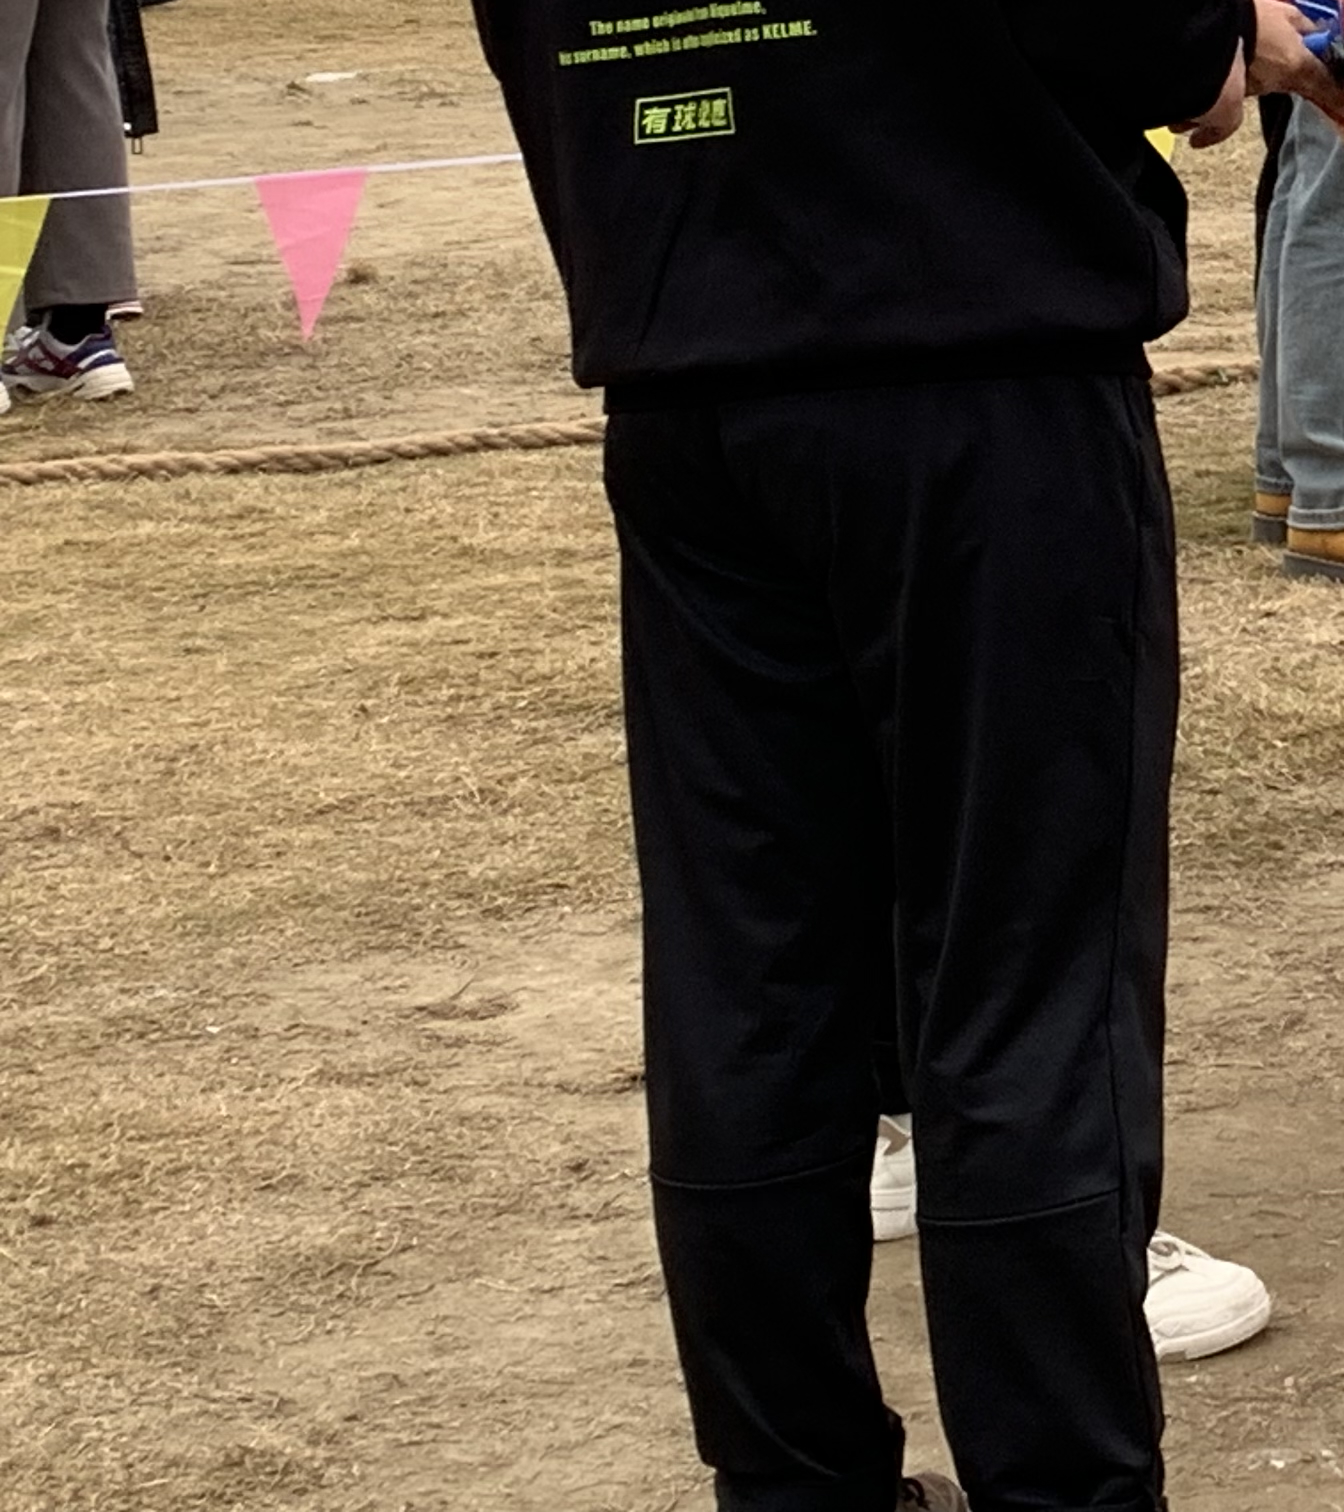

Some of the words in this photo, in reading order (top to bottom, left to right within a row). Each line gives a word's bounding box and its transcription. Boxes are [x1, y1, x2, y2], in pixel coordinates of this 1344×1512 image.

[589, 21, 613, 35] The
[616, 18, 650, 32] name
[745, 28, 759, 41] as
